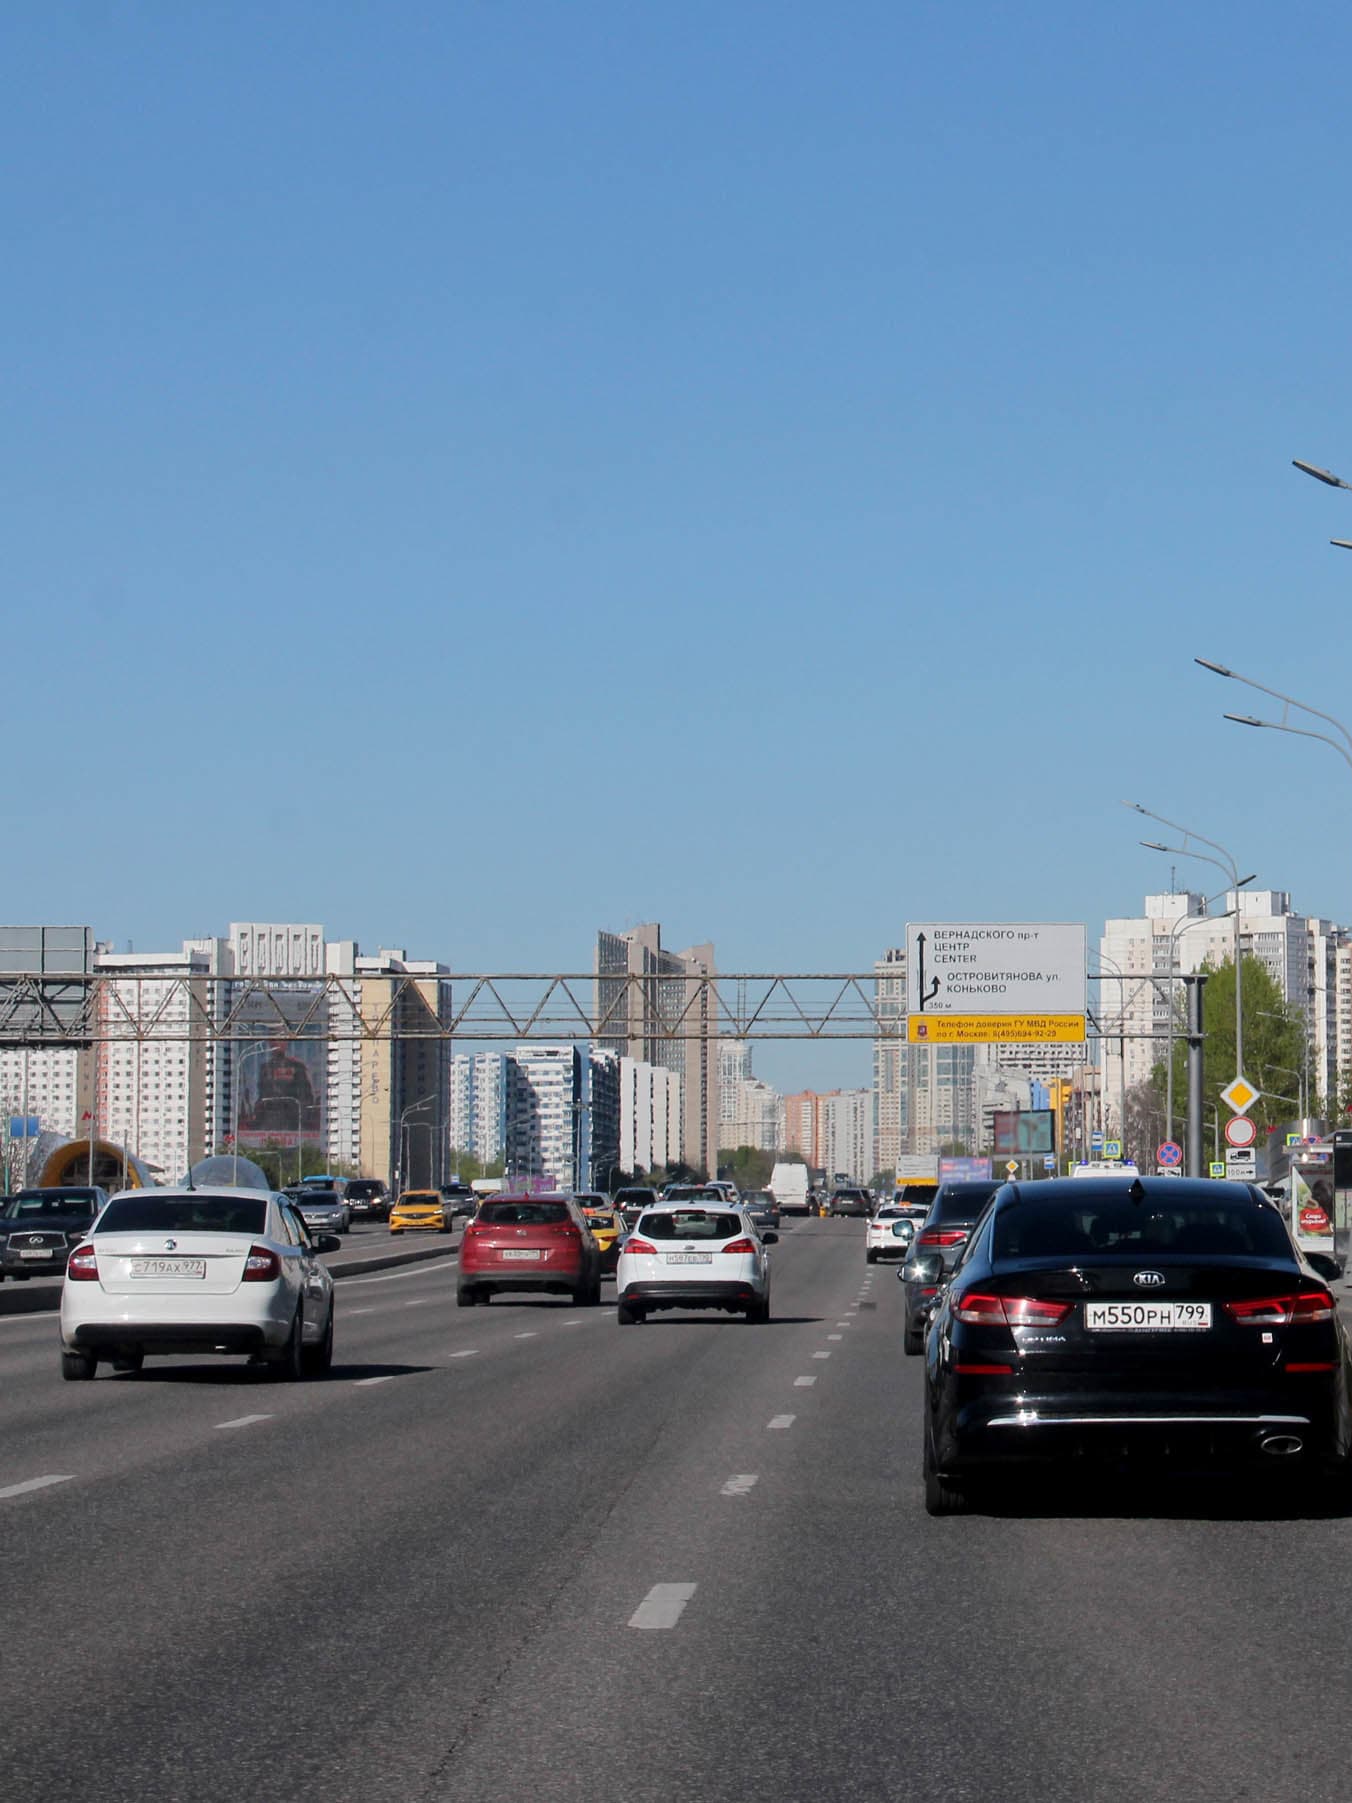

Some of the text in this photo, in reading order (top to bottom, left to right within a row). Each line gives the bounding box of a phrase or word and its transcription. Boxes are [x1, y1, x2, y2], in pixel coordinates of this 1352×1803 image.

[934, 930, 1039, 941] ВЕРНАДСКОГО пр-т
[934, 942, 970, 952] ЦЕНТР
[934, 954, 977, 963] CENTER
[947, 972, 1043, 982] ОСТРОВИТЯНОВА
[946, 984, 1007, 993] КОНЬКОВО
[937, 1020, 1079, 1029] Телефон доверия ГУ МВД России
[1138, 1274, 1161, 1284] KIA
[1093, 1305, 1205, 1325] М550РН 799
